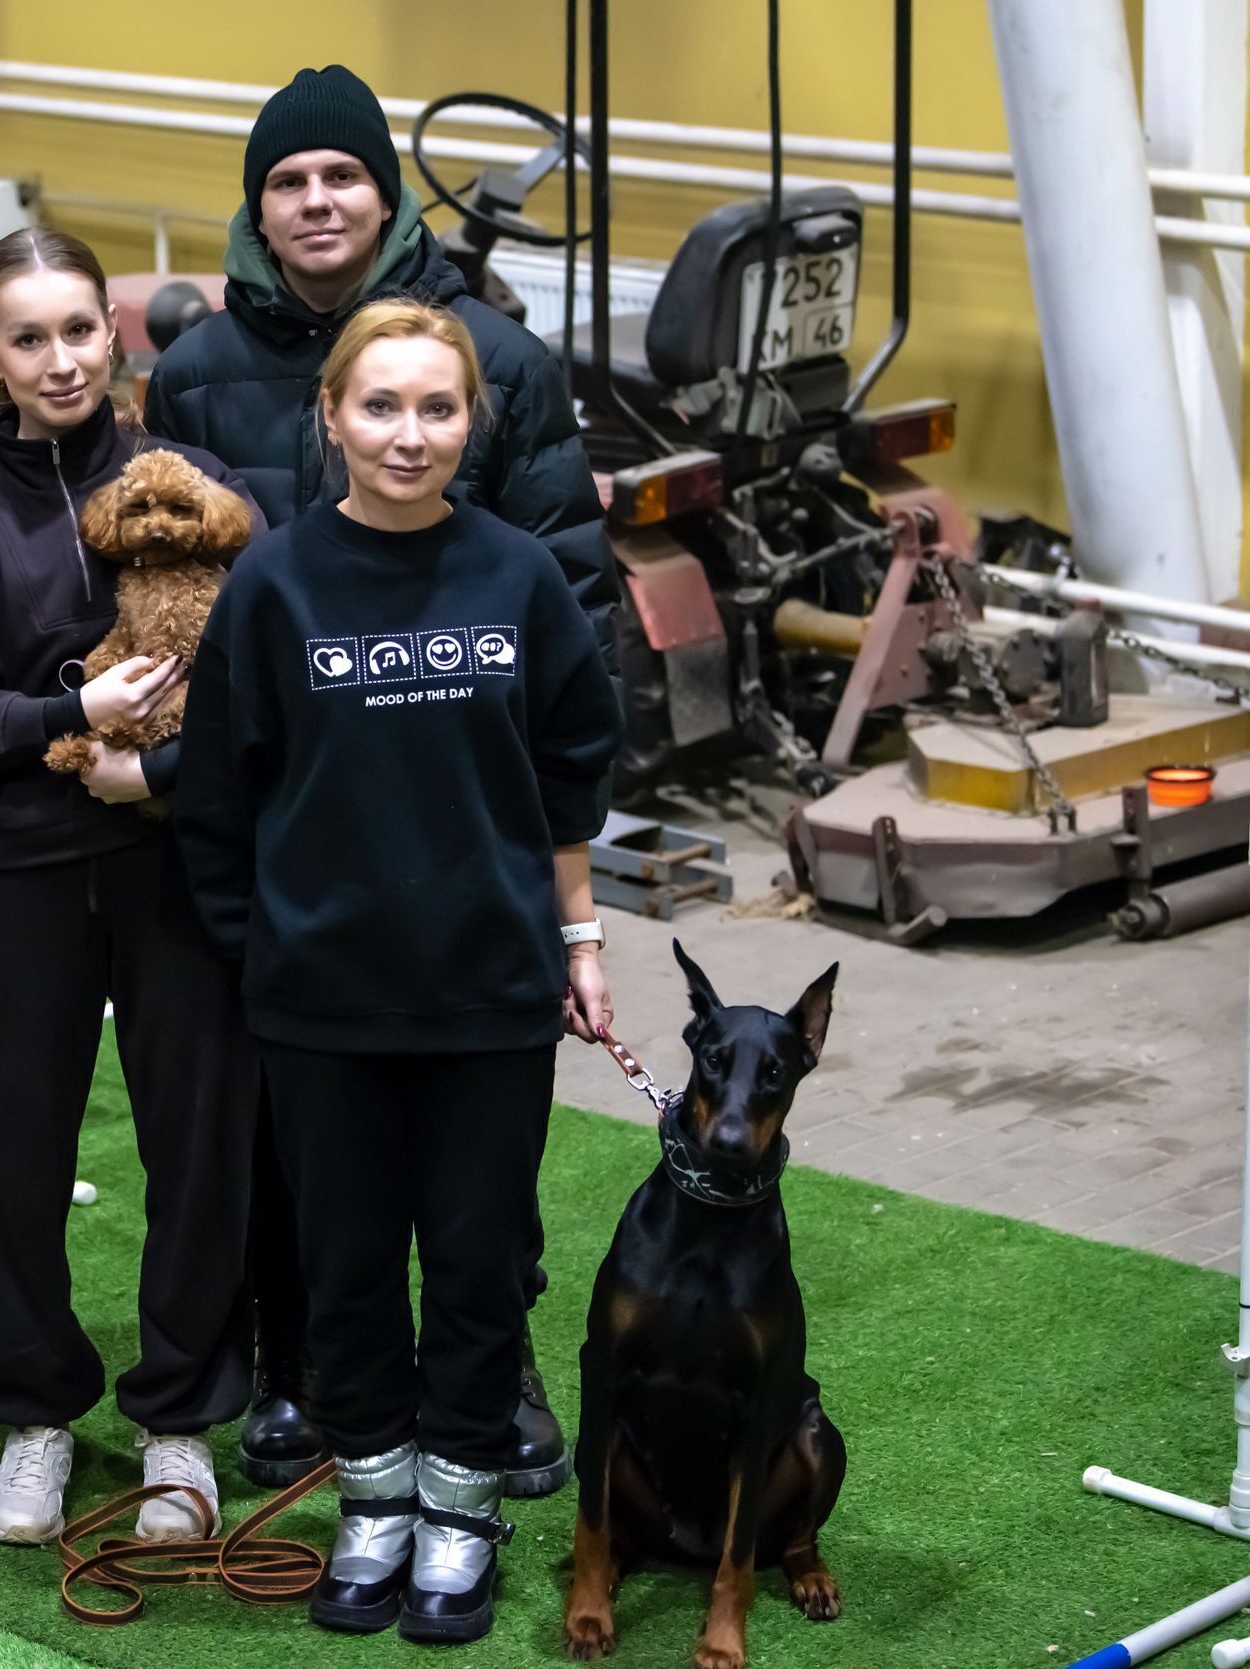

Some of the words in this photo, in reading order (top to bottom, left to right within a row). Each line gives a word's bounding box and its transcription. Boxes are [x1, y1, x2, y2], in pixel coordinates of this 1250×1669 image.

[762, 257, 843, 309] 252
[814, 314, 843, 348] 46
[365, 693, 405, 707] MOOD
[407, 691, 424, 703] OF
[425, 688, 447, 701] THE
[449, 686, 474, 699] DAY
